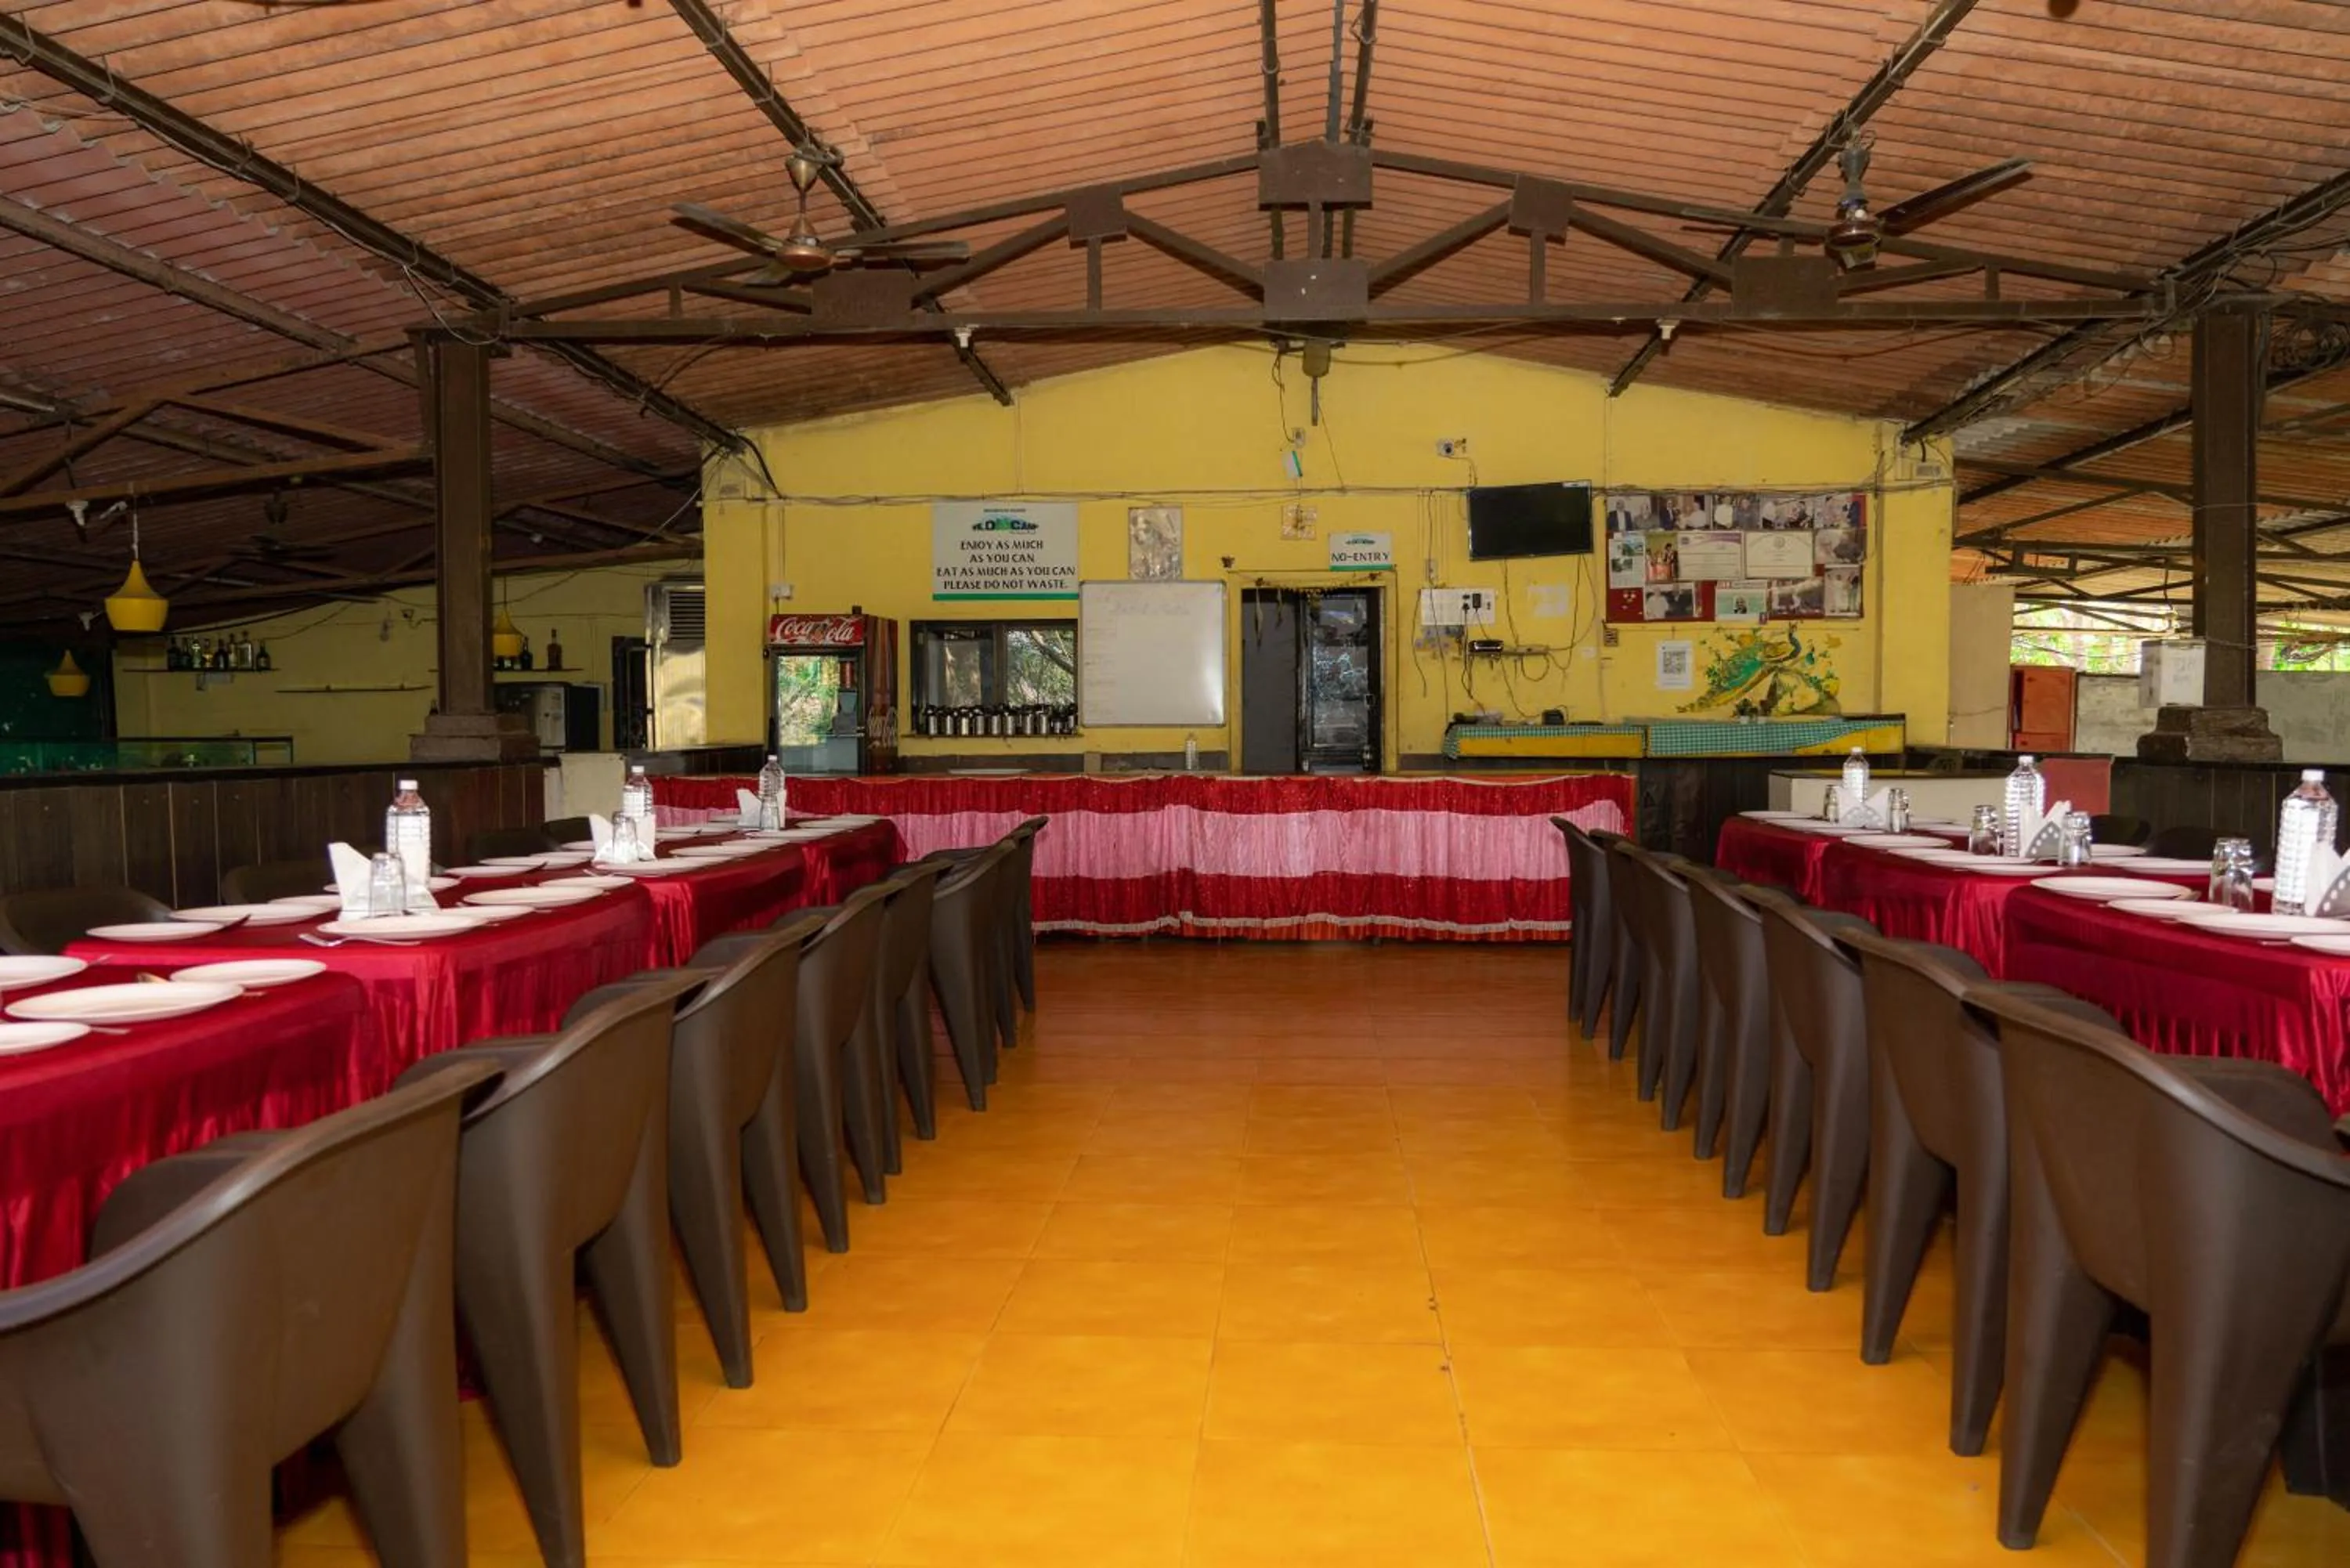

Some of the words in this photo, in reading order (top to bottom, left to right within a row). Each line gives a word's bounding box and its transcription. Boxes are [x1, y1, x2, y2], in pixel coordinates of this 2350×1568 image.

[960, 540, 992, 551] ENJOY
[996, 540, 1010, 550] AS
[1012, 540, 1043, 549] MUCH
[970, 555, 983, 563] AS
[987, 554, 1010, 563] YOU
[1012, 554, 1035, 563] CAN
[1331, 551, 1390, 562] NO-ENTRY
[937, 567, 957, 577] EAT
[960, 567, 974, 576] AS
[977, 567, 1007, 576] MUCH
[1010, 567, 1023, 576] AS
[1027, 566, 1050, 576] YOU
[1052, 566, 1076, 576] CAN
[943, 580, 981, 590] PLEASE
[984, 580, 1000, 589] DO
[1003, 580, 1023, 588] NOT
